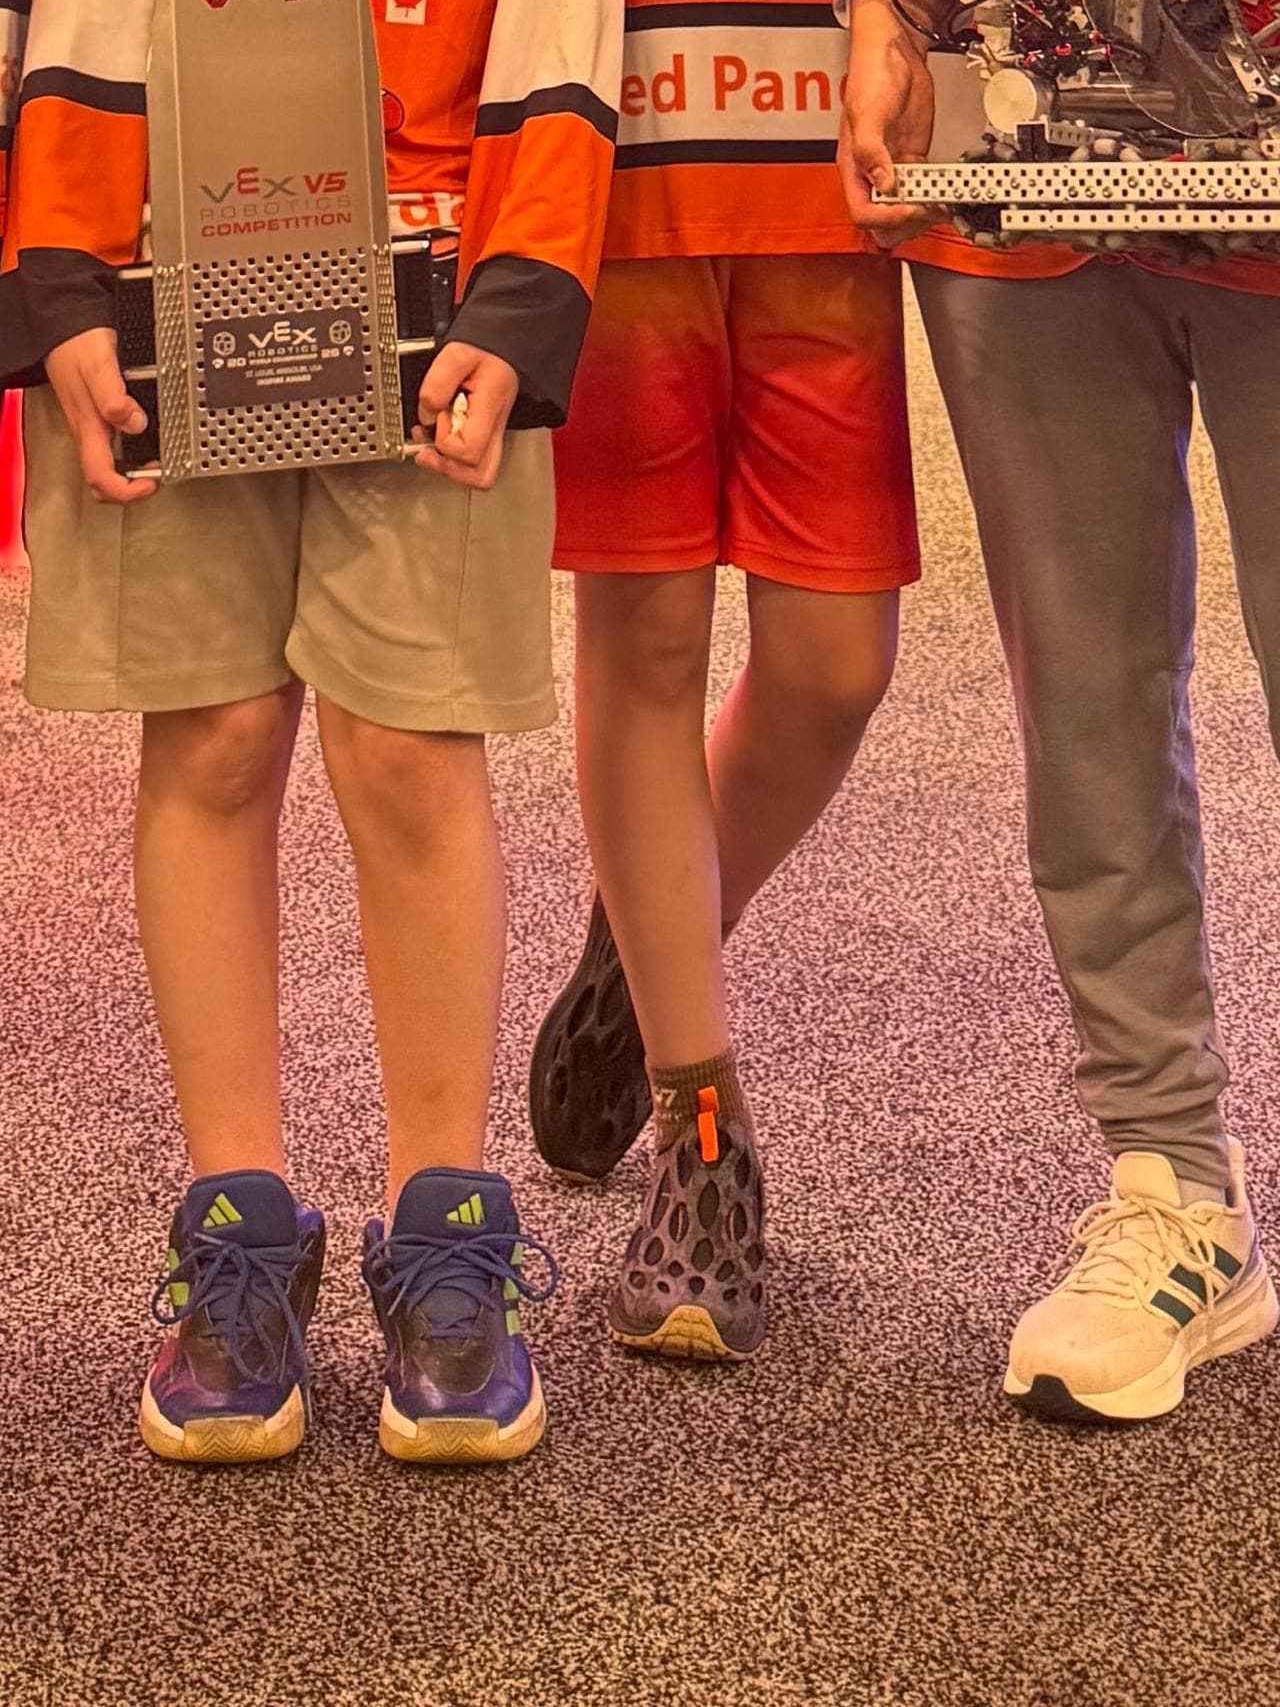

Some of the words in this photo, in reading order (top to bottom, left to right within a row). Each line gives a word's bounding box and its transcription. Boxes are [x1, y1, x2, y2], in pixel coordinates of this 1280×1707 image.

[620, 54, 687, 116] ed
[713, 55, 849, 112] Pan
[200, 167, 297, 203] VEX
[303, 171, 348, 194] V5
[200, 195, 352, 222] ROBOTICS
[201, 212, 352, 238] COMPETITION
[248, 321, 317, 348] VEX
